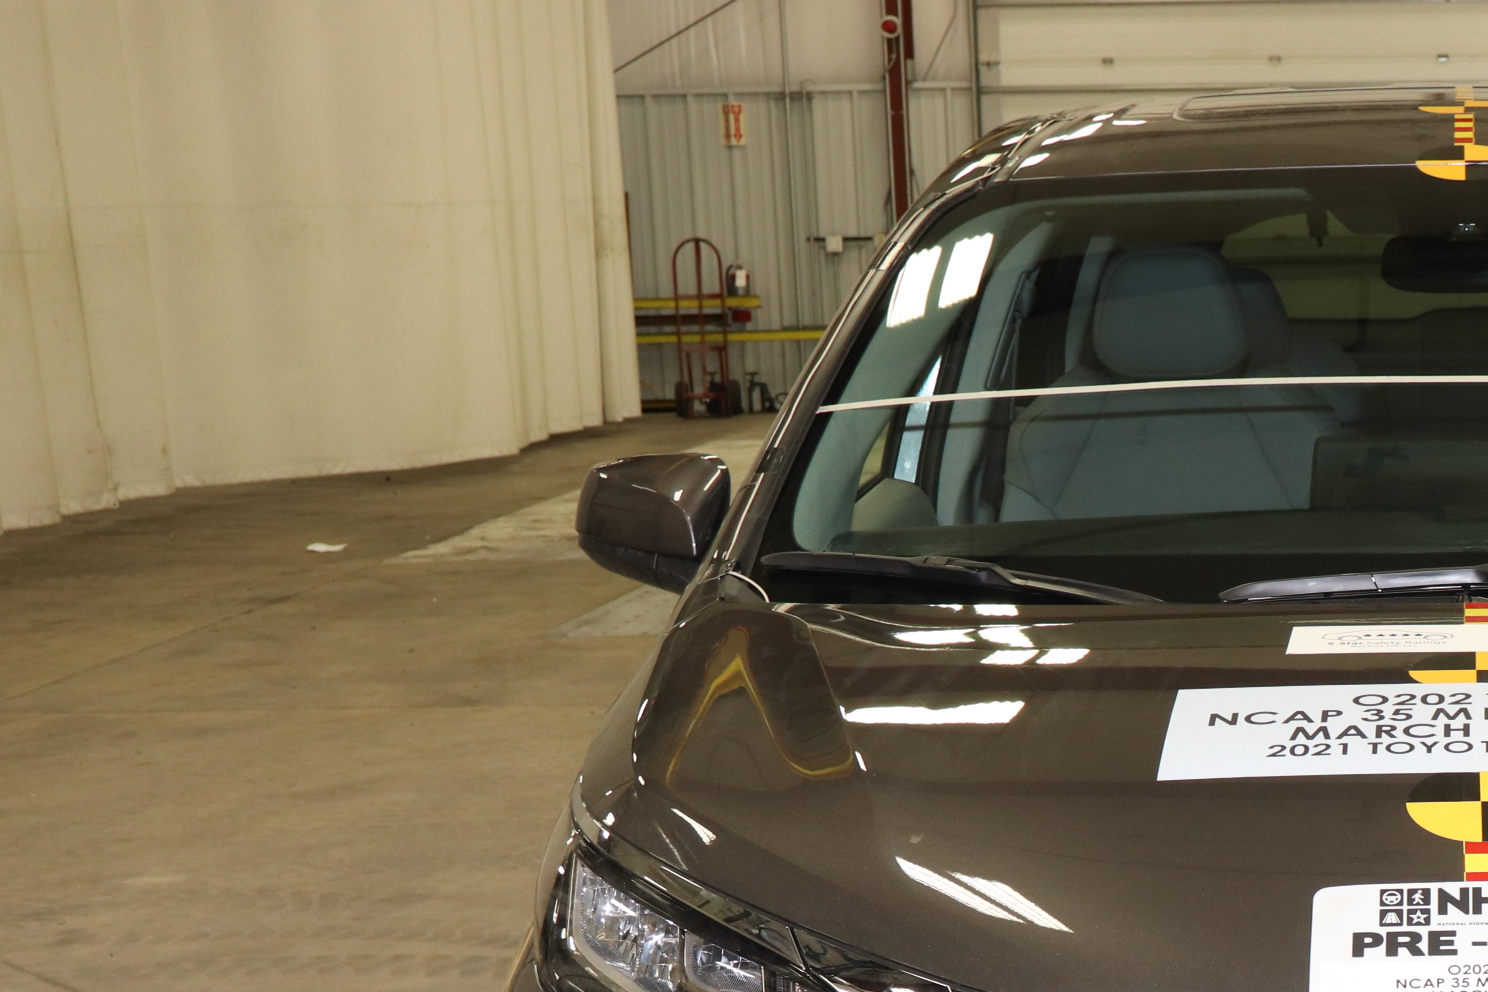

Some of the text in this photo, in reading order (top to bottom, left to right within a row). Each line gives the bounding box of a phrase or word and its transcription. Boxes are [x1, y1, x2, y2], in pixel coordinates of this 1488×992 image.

[1208, 709, 1344, 727] NCAP
[1361, 708, 1414, 722] 35
[1289, 723, 1471, 741] MARCH
[1266, 742, 1349, 758] 2021
[1351, 930, 1458, 958] PRE
[1396, 978, 1445, 989] NCAP
[1451, 977, 1470, 988] 35
